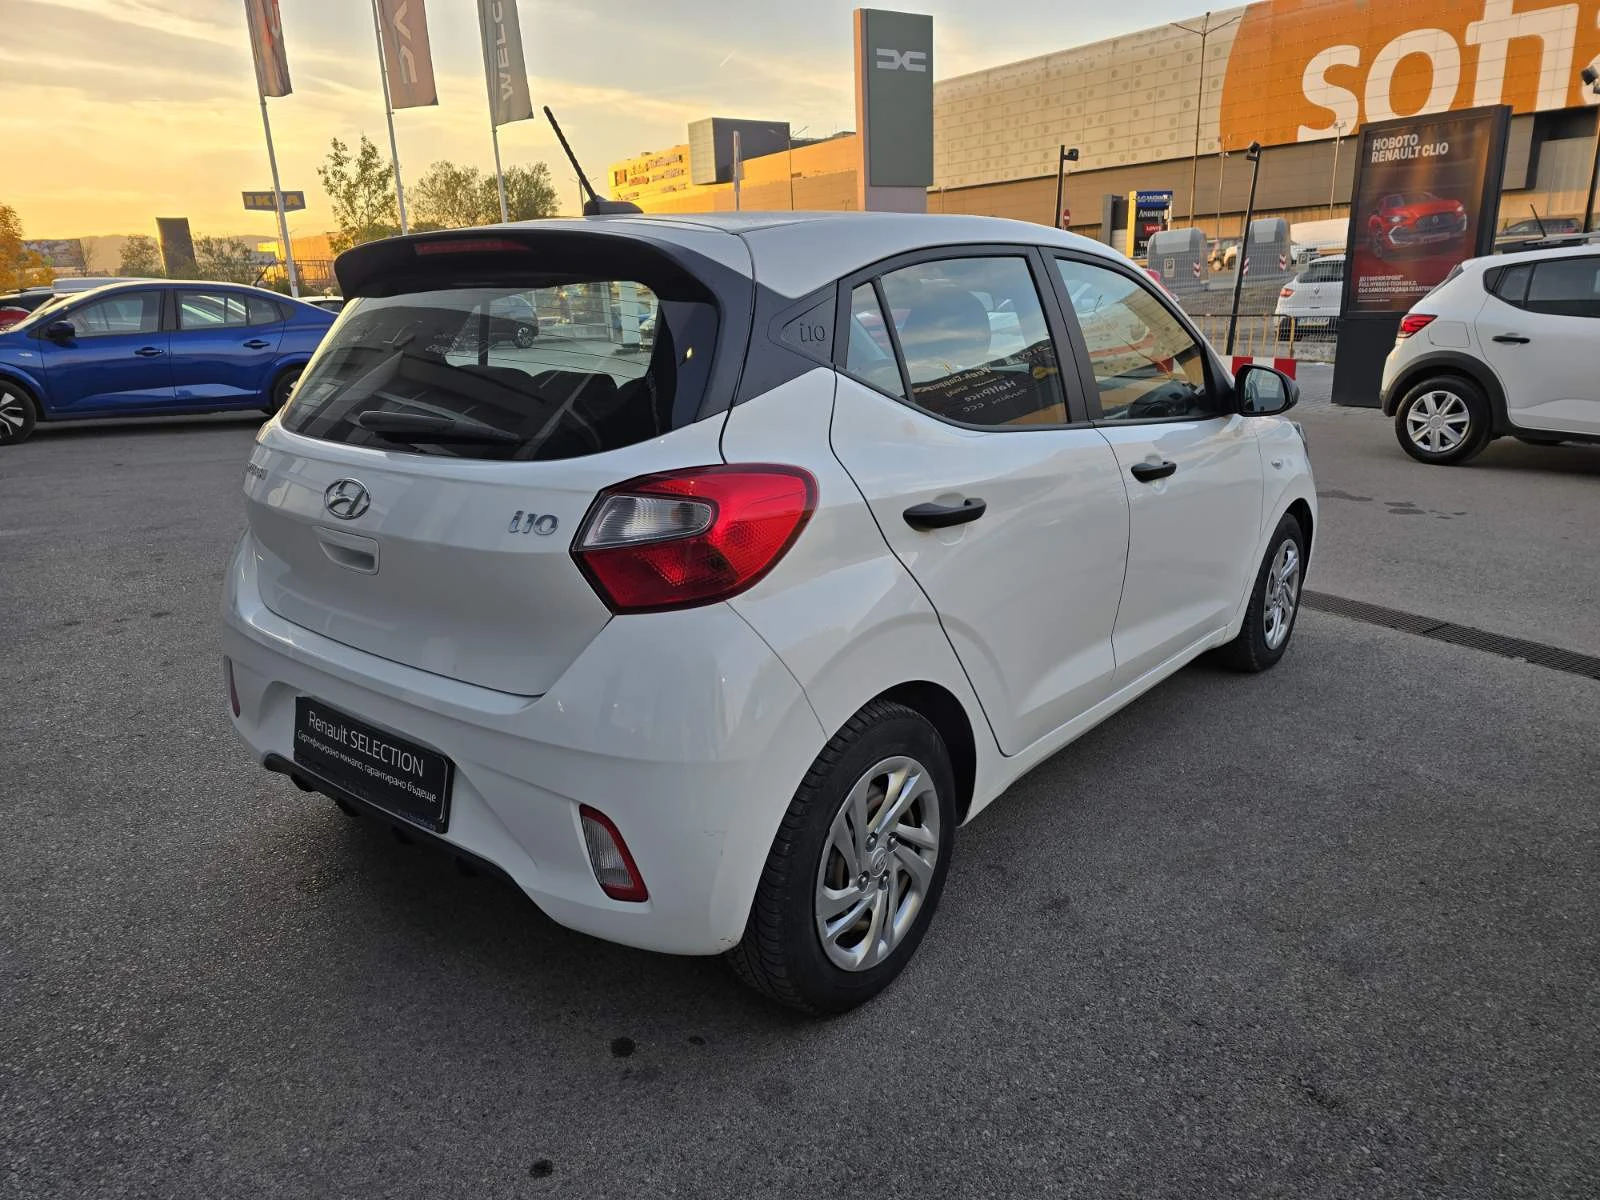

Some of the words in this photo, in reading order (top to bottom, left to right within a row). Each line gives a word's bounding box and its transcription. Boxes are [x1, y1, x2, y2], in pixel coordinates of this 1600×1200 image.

[1297, 0, 1600, 142] sofi
[1371, 145, 1421, 163] RENAULT
[1421, 142, 1449, 157] CLIO
[1372, 133, 1419, 151] НОВОТО
[246, 194, 300, 207] IKA
[508, 510, 560, 536] i10
[308, 710, 348, 745] Renault
[350, 730, 424, 777] SELECTION
[297, 729, 339, 759] Сертифицирано
[364, 764, 406, 790] гарантирано
[407, 781, 437, 803] бъдеще
